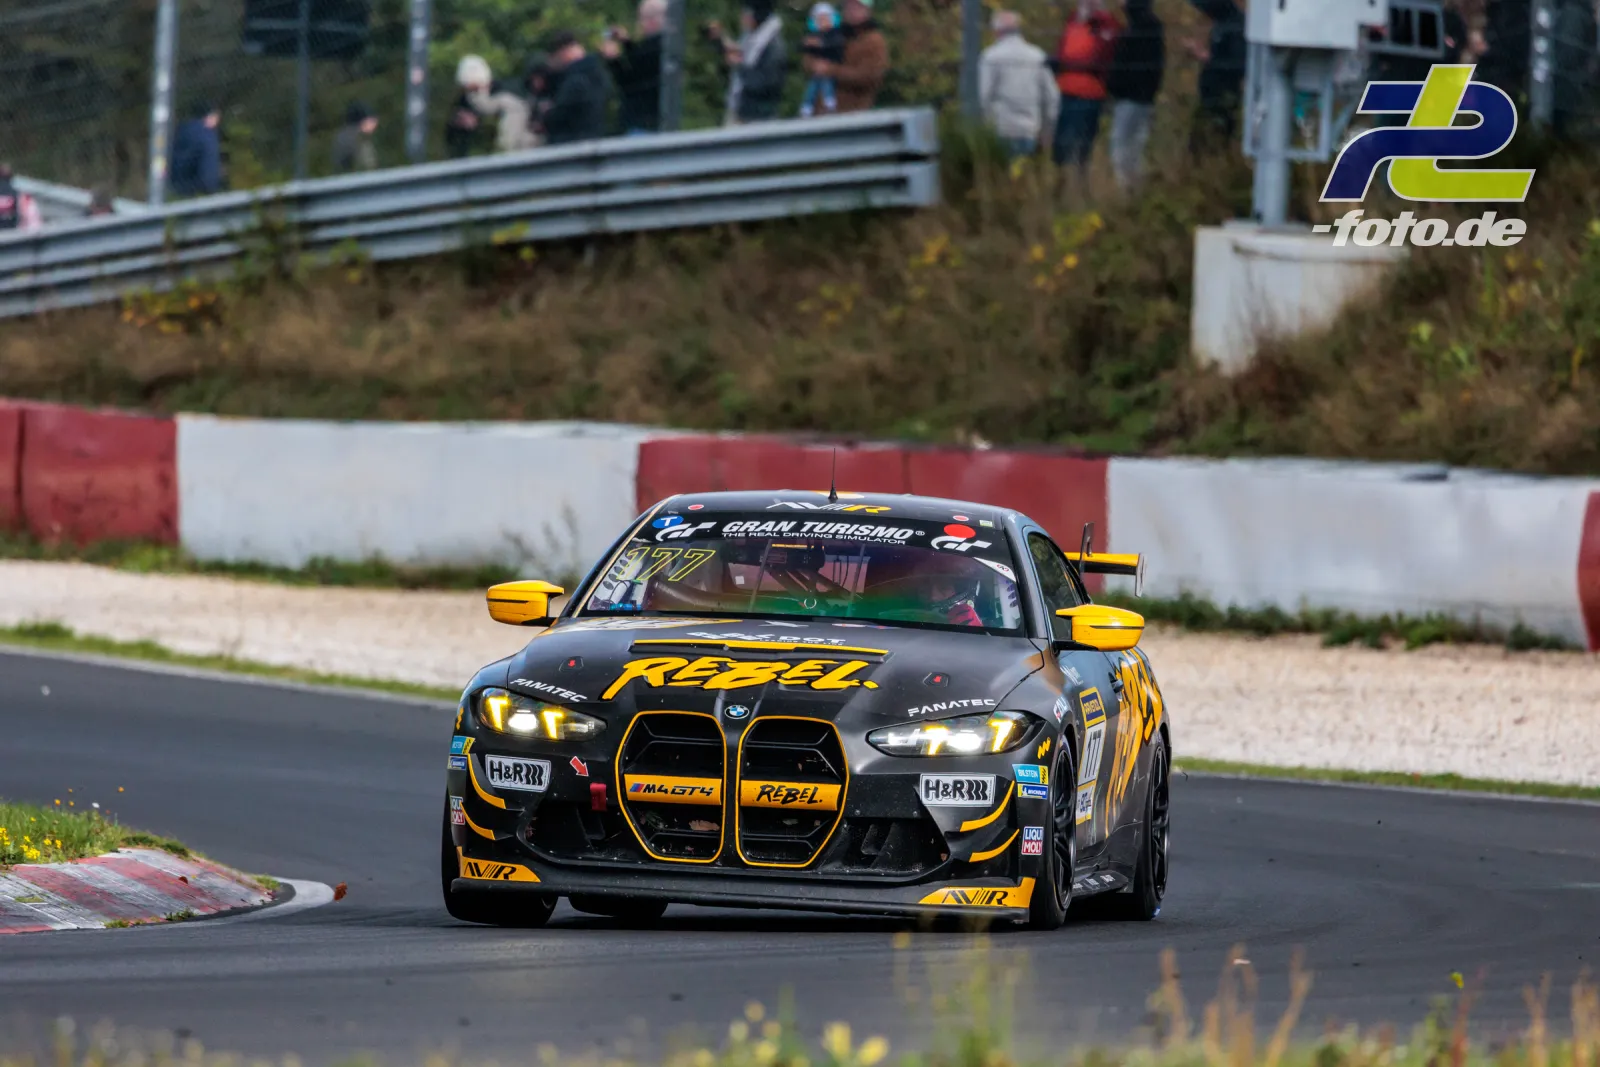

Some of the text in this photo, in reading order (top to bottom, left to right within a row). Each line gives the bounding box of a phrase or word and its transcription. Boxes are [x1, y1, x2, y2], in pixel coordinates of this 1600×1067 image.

[722, 521, 797, 533] GRAN
[835, 534, 906, 545] SIMULATOR
[616, 547, 717, 581] 177
[510, 678, 588, 702] FANATEC
[908, 699, 995, 717] FANATEC
[1023, 841, 1042, 853] MOLY
